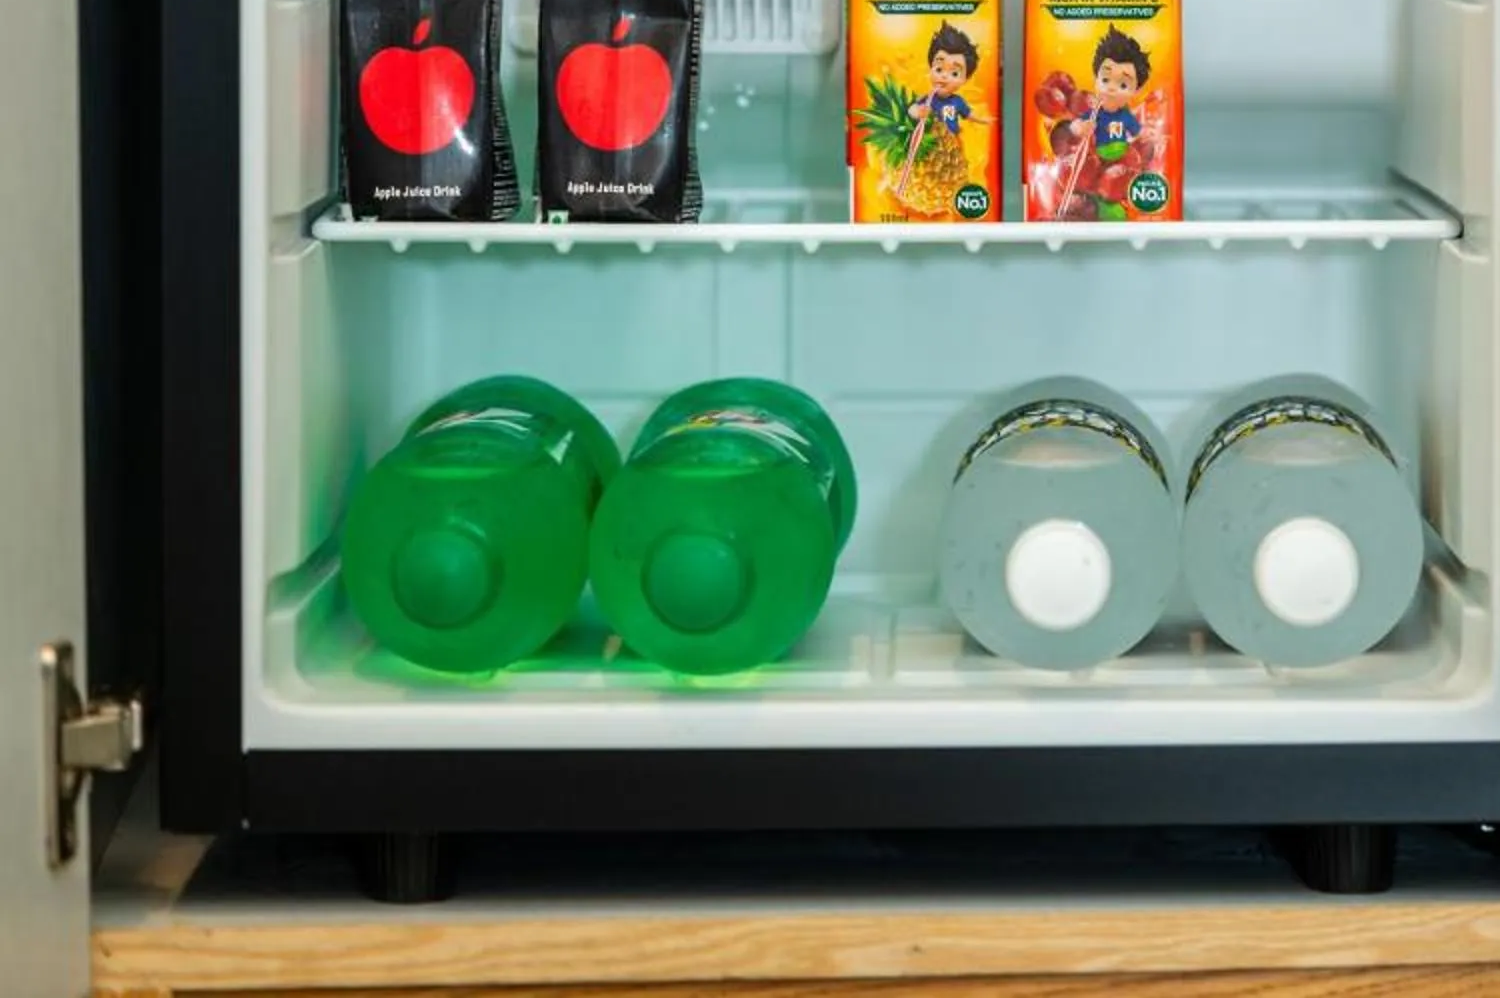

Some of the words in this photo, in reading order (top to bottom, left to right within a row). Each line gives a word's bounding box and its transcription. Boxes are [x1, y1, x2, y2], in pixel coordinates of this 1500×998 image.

[373, 186, 400, 200] Apple
[402, 186, 431, 197] Juice
[433, 186, 462, 197] Drink
[567, 181, 595, 195] Apple
[596, 182, 625, 193] Juice
[627, 183, 655, 194] Drink
[1132, 185, 1167, 201] No.1
[957, 195, 987, 209] No.1
